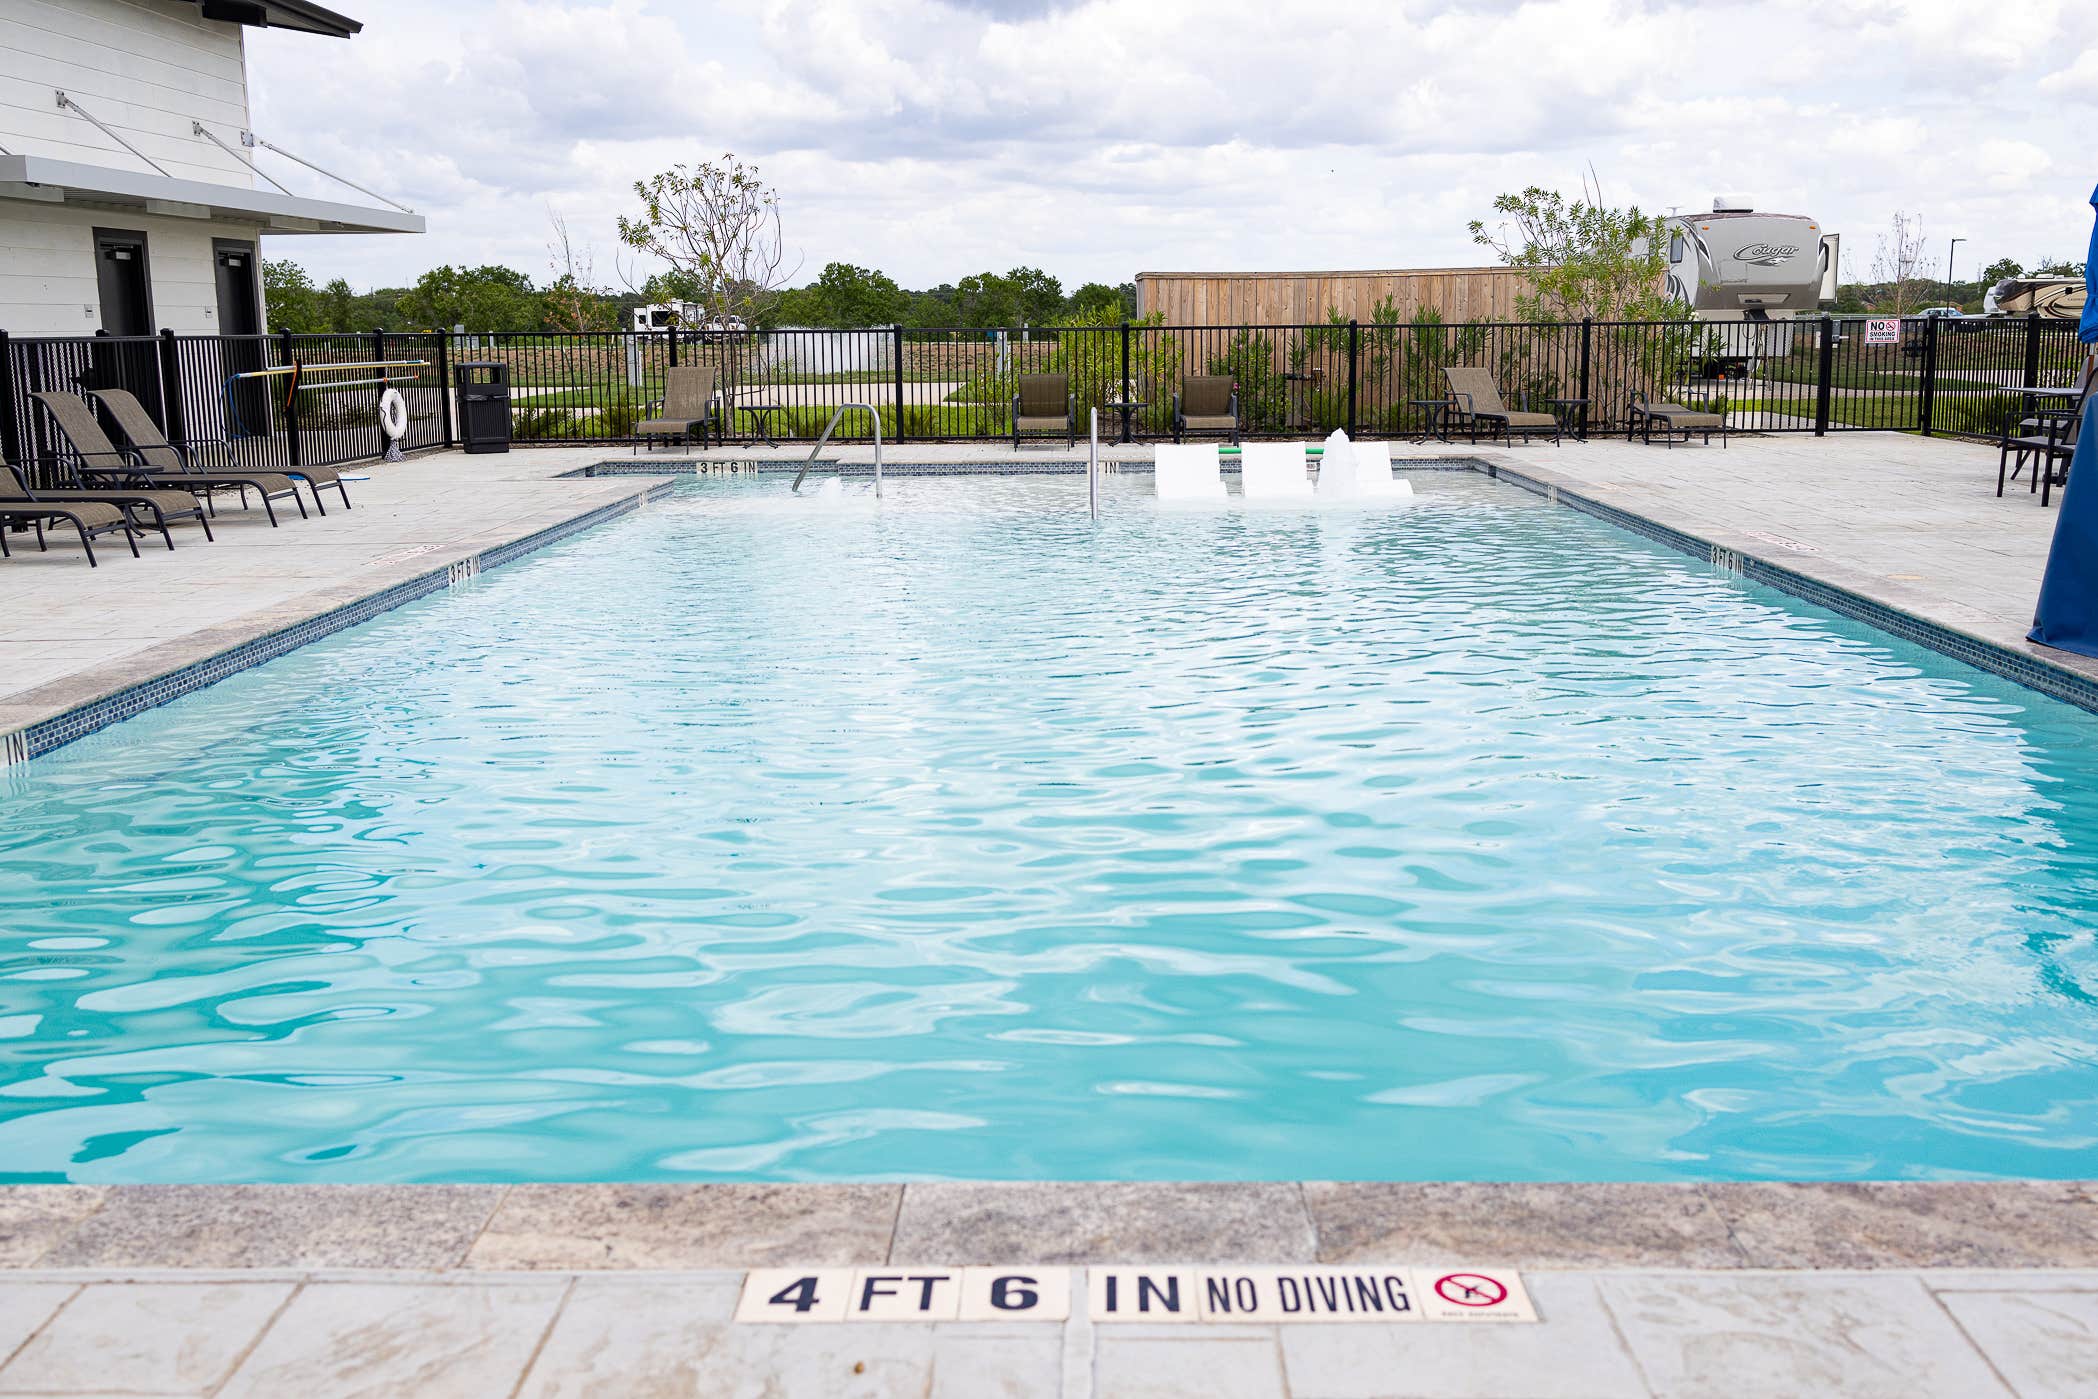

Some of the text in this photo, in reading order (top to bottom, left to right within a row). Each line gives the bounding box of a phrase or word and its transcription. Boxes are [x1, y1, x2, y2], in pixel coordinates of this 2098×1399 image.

[1733, 243, 1800, 261] Cougar
[1870, 321, 1885, 331] NO
[700, 461, 755, 475] 3 FT 6 IN
[1105, 462, 1117, 474] IN
[1713, 547, 1718, 564] 3
[1719, 548, 1726, 567] FT
[1728, 552, 1733, 570] 6
[450, 565, 456, 583] 3
[457, 562, 464, 581] FT
[466, 559, 471, 577] 6
[5, 730, 24, 766] IN
[768, 1275, 1180, 1313] 4 FT 6 IN
[1207, 1276, 1411, 1313] NO DIVING
